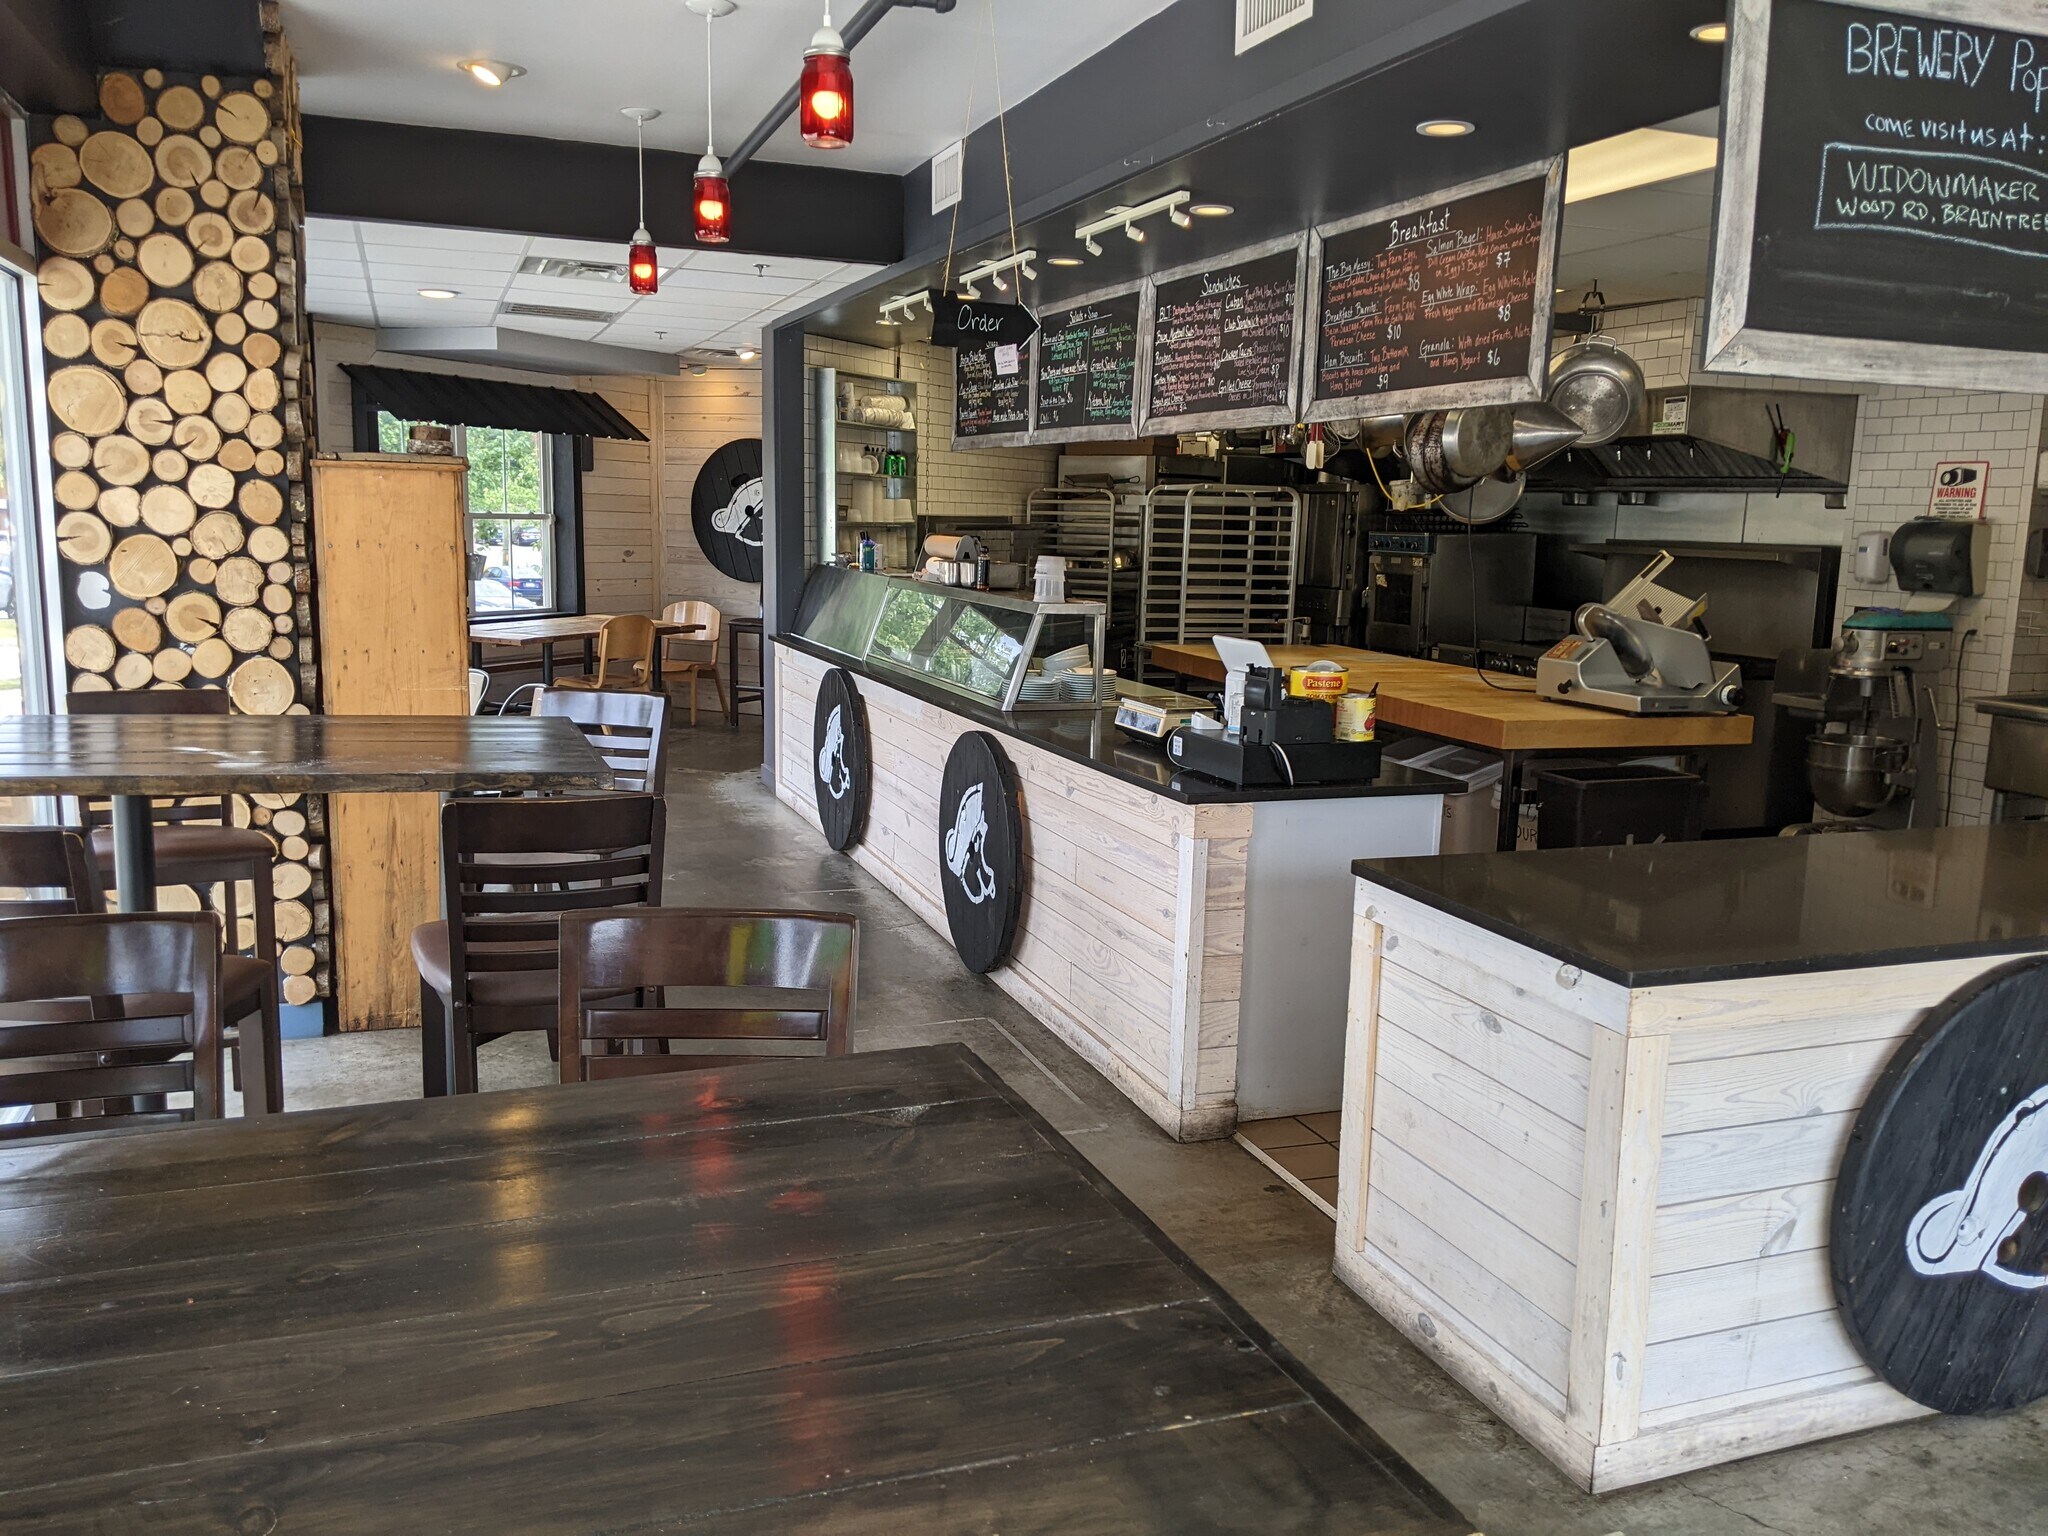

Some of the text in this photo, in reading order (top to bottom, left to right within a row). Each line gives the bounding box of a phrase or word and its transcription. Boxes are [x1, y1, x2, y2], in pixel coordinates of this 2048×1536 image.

[1847, 22, 1996, 88] BREWERY
[1847, 160, 2041, 206] WIDOWMAKER
[1836, 196, 1895, 220] WOOD
[1388, 206, 1451, 248] Breakfast
[1426, 238, 1454, 256] Salmon
[1456, 226, 1483, 252] Bagel:
[1326, 264, 1340, 280] The
[1340, 261, 1352, 276] Big
[1376, 253, 1387, 268] Two
[1388, 250, 1402, 264] Farm
[1467, 257, 1489, 276] Bagel
[1496, 250, 1511, 269] $7
[1201, 273, 1241, 296] Sandwiches
[1407, 271, 1420, 292] $8
[1421, 289, 1436, 313] Egg
[1436, 286, 1454, 300] White
[1482, 277, 1498, 299] Egg
[1424, 291, 1530, 322] Fresh Veggies and Parmesan Cheese
[957, 303, 1005, 332] Order
[1324, 306, 1354, 324] Breakfast
[1384, 296, 1401, 314] Farm
[1497, 303, 1511, 322] $8
[1224, 318, 1237, 331] Club
[1279, 322, 1290, 339] $10
[1330, 324, 1402, 348] Parmesan Cheese $10
[1419, 337, 1455, 360] Granola:
[1474, 332, 1491, 347] dried
[1491, 328, 1513, 341] Fruits,
[1324, 354, 1338, 368] Ham
[1339, 348, 1367, 366] Biscuits:
[1370, 348, 1381, 363] Two
[1389, 362, 1400, 373] and
[1429, 347, 1501, 373] and Honey Yogurt $6
[1270, 363, 1280, 379] $8
[1278, 389, 1287, 404] $9
[1329, 381, 1344, 396] Honey
[1376, 373, 1389, 390] $9
[1937, 487, 1977, 498] WARNING
[1306, 678, 1341, 688] Pastene
